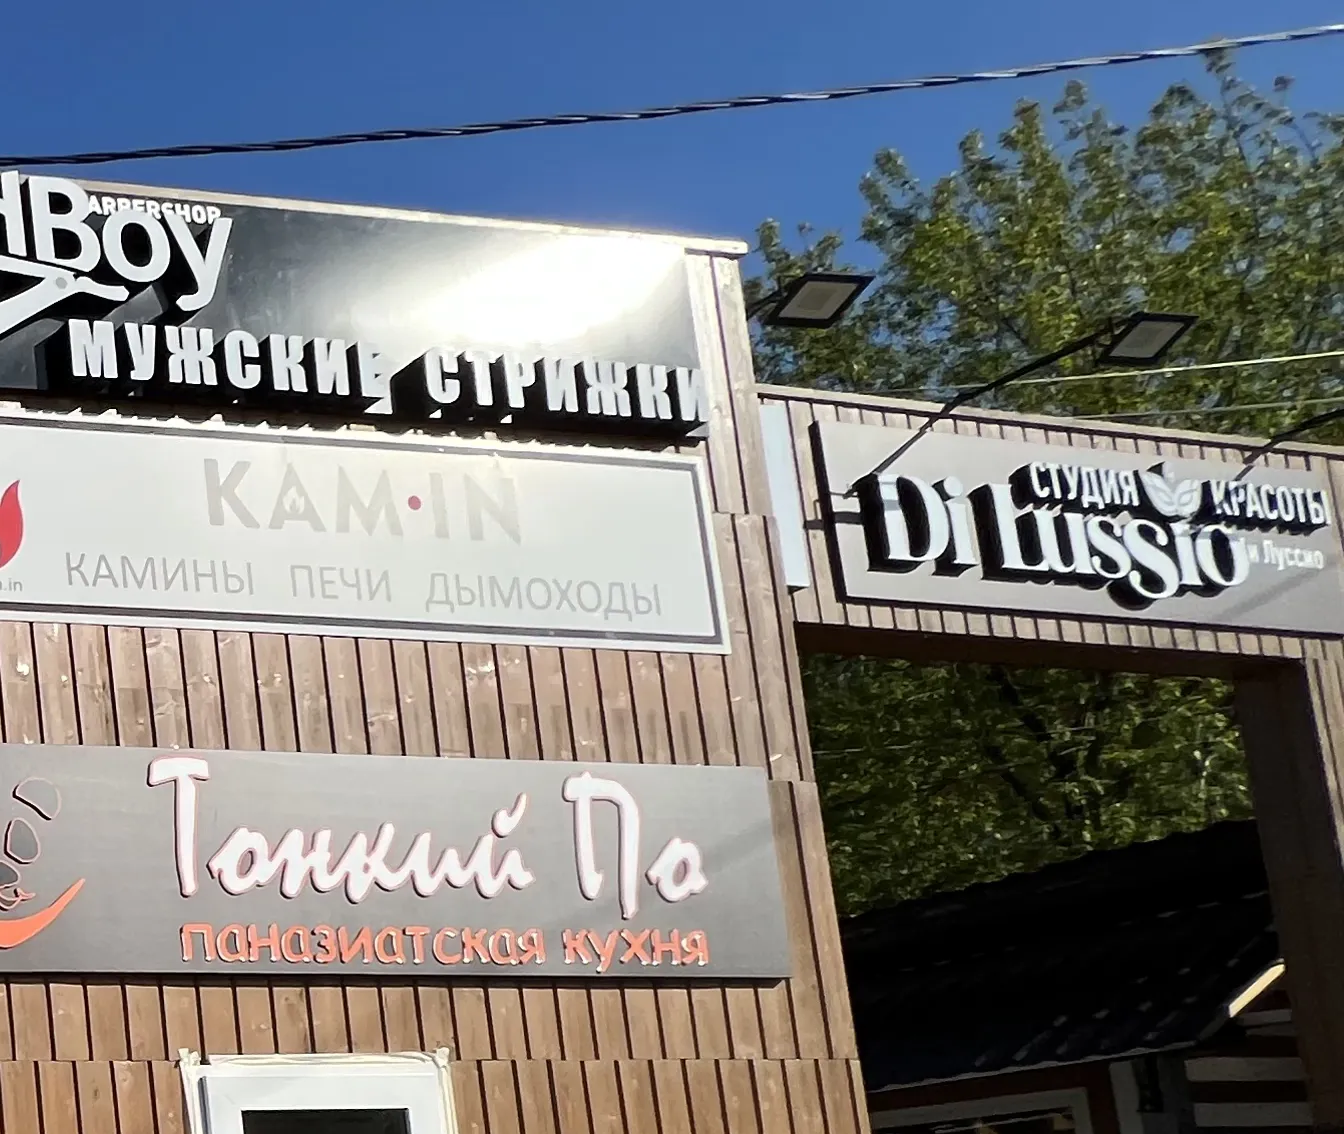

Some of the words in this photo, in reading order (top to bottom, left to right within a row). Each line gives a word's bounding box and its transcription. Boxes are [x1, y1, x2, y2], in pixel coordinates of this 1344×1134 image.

[68, 317, 390, 399] МУЖСКИЕ
[424, 346, 708, 422] СТРИЖКИ
[1028, 461, 1141, 510] СТУДИЯ
[1209, 479, 1332, 525] КРАСОТЫ
[65, 551, 255, 596] КАМИНЫ
[289, 564, 393, 603] ПЕЧИ
[425, 572, 662, 621] ДЫМОХОДЫ
[147, 756, 535, 904] Тонкий
[562, 770, 709, 920] По
[179, 922, 546, 967] паназиатская
[562, 926, 710, 973] кухня
